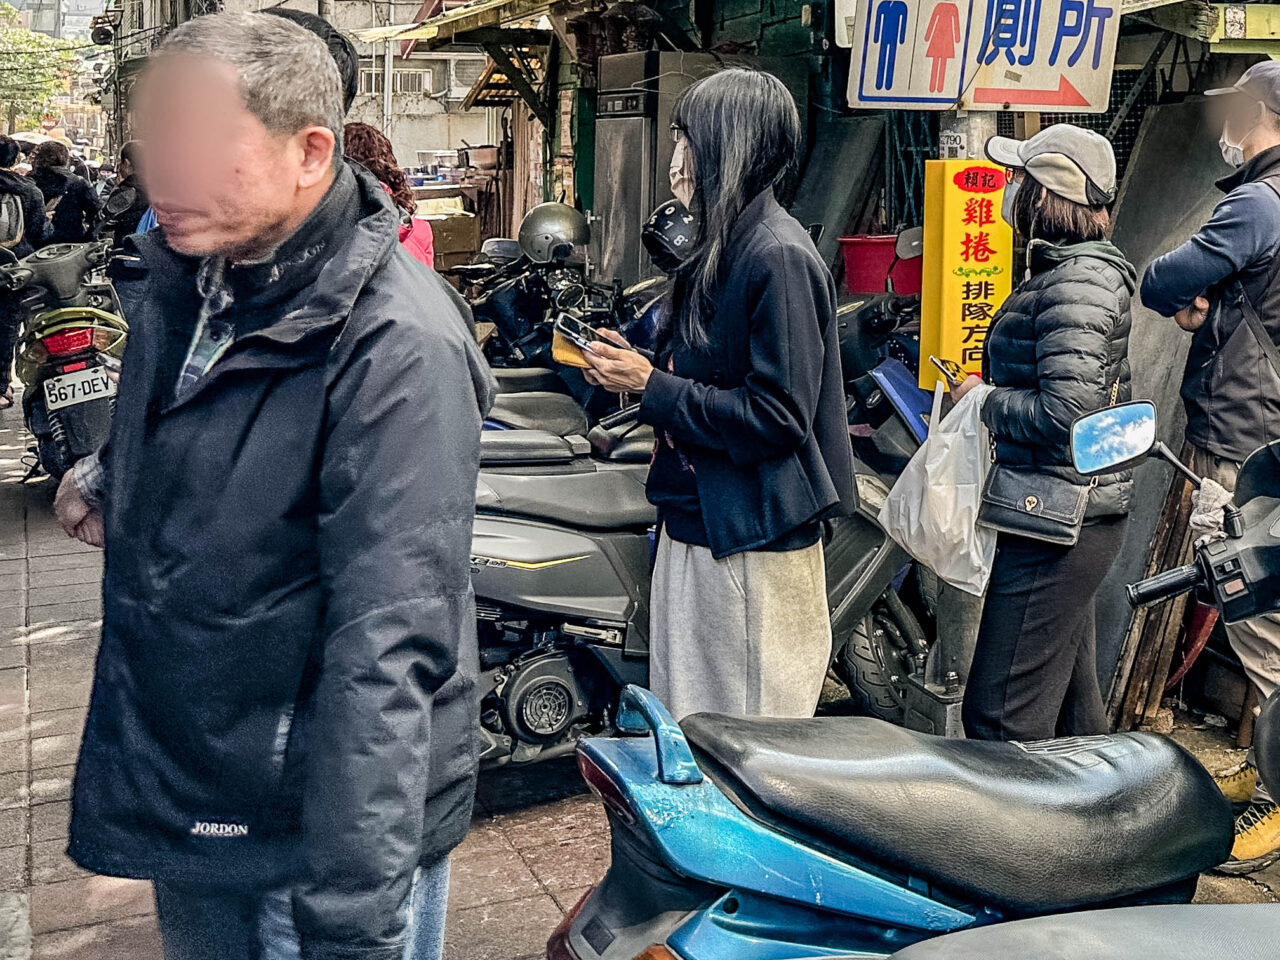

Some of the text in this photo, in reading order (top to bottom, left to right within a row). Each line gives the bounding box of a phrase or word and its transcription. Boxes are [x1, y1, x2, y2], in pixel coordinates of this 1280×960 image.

[964, 171, 997, 188] 賴記
[960, 197, 998, 263] 雞捲
[191, 822, 248, 835] JORDON
